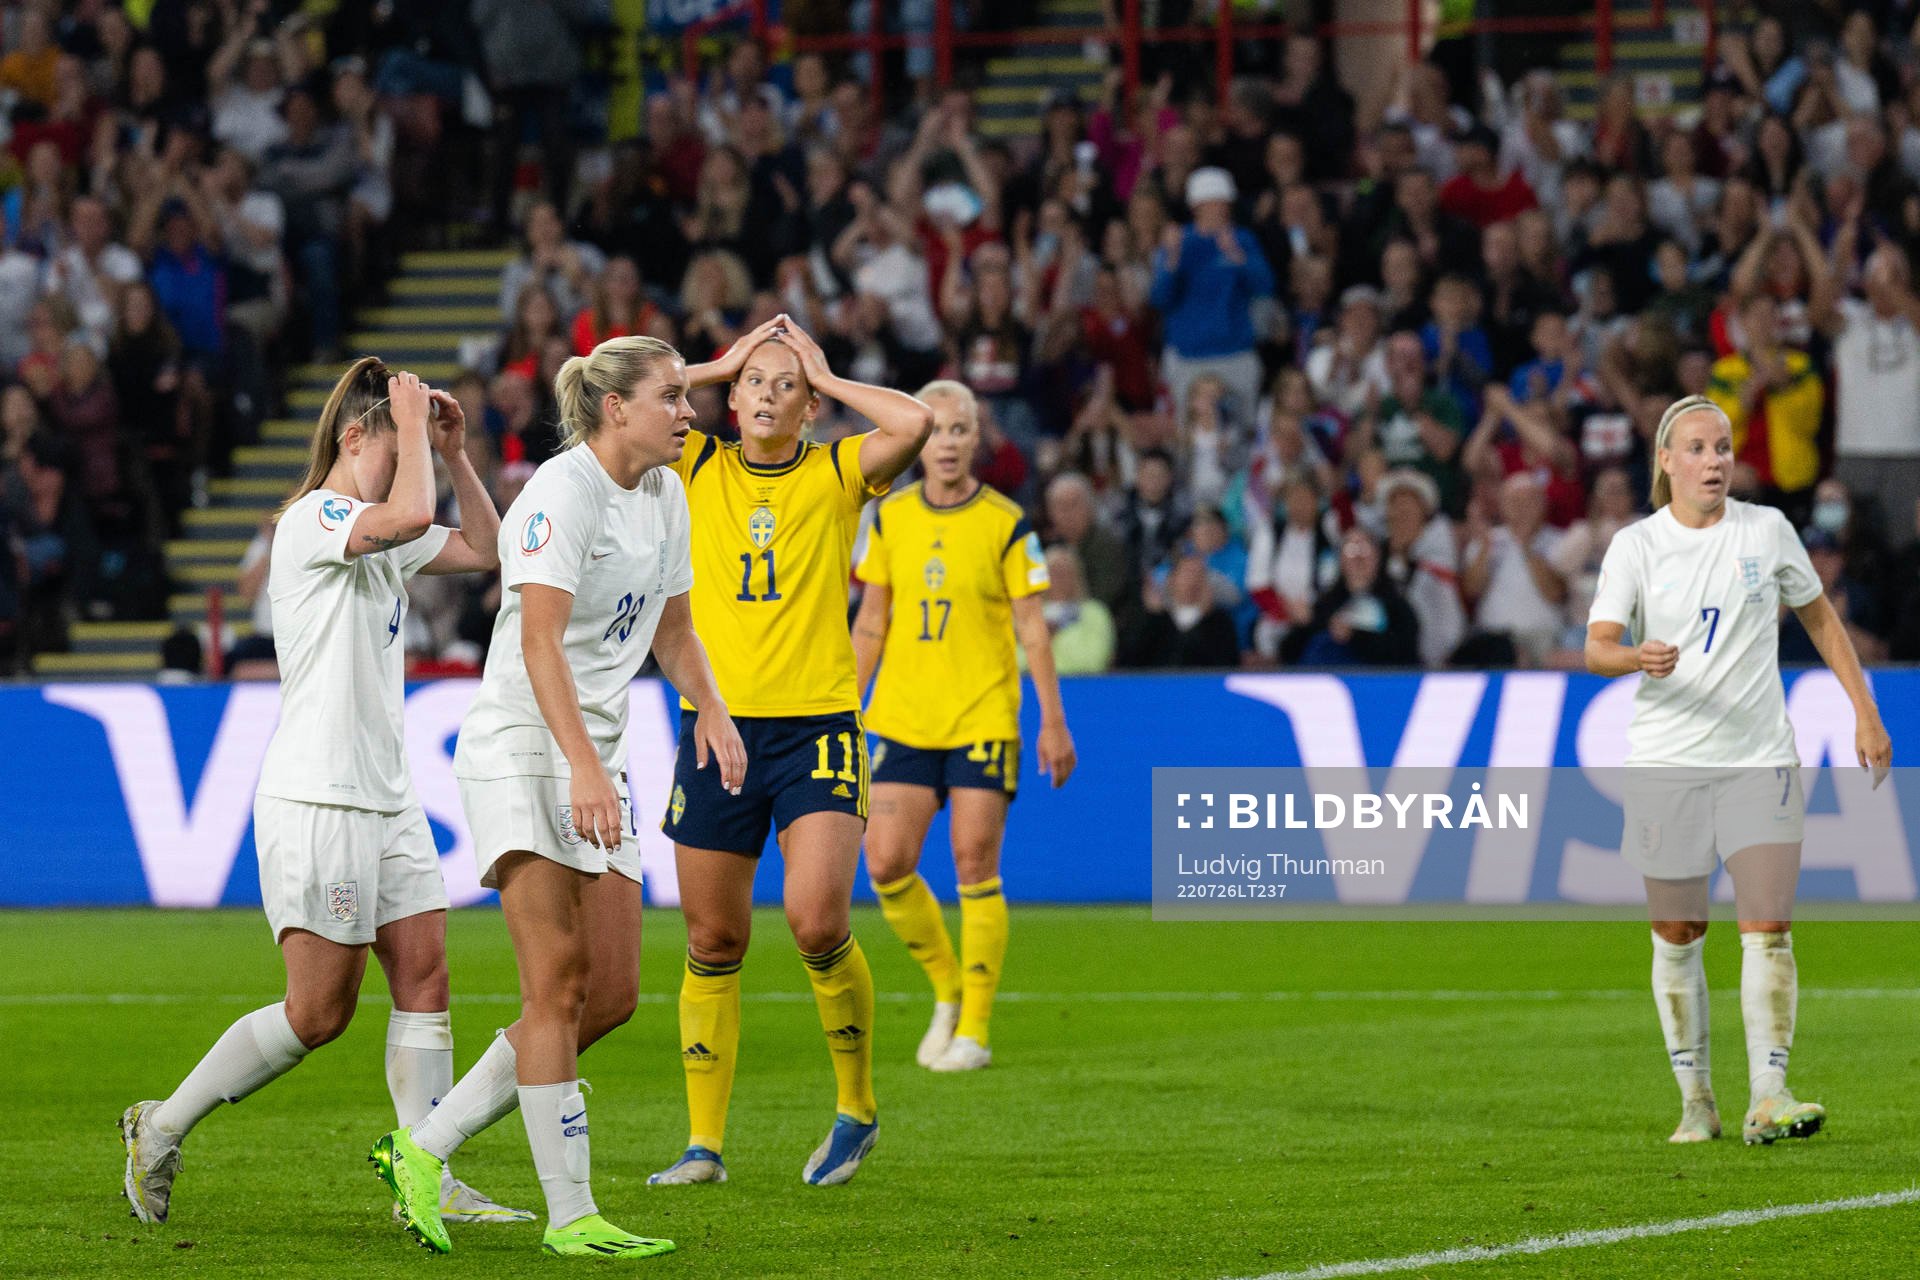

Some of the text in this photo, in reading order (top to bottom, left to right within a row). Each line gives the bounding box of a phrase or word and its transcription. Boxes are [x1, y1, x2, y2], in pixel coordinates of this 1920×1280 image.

[736, 550, 782, 601] 11
[383, 595, 401, 650] 4
[602, 591, 646, 643] 23
[918, 598, 952, 641] 17
[1701, 607, 1721, 654] 7
[811, 731, 857, 783] 11
[1775, 766, 1791, 806] 7
